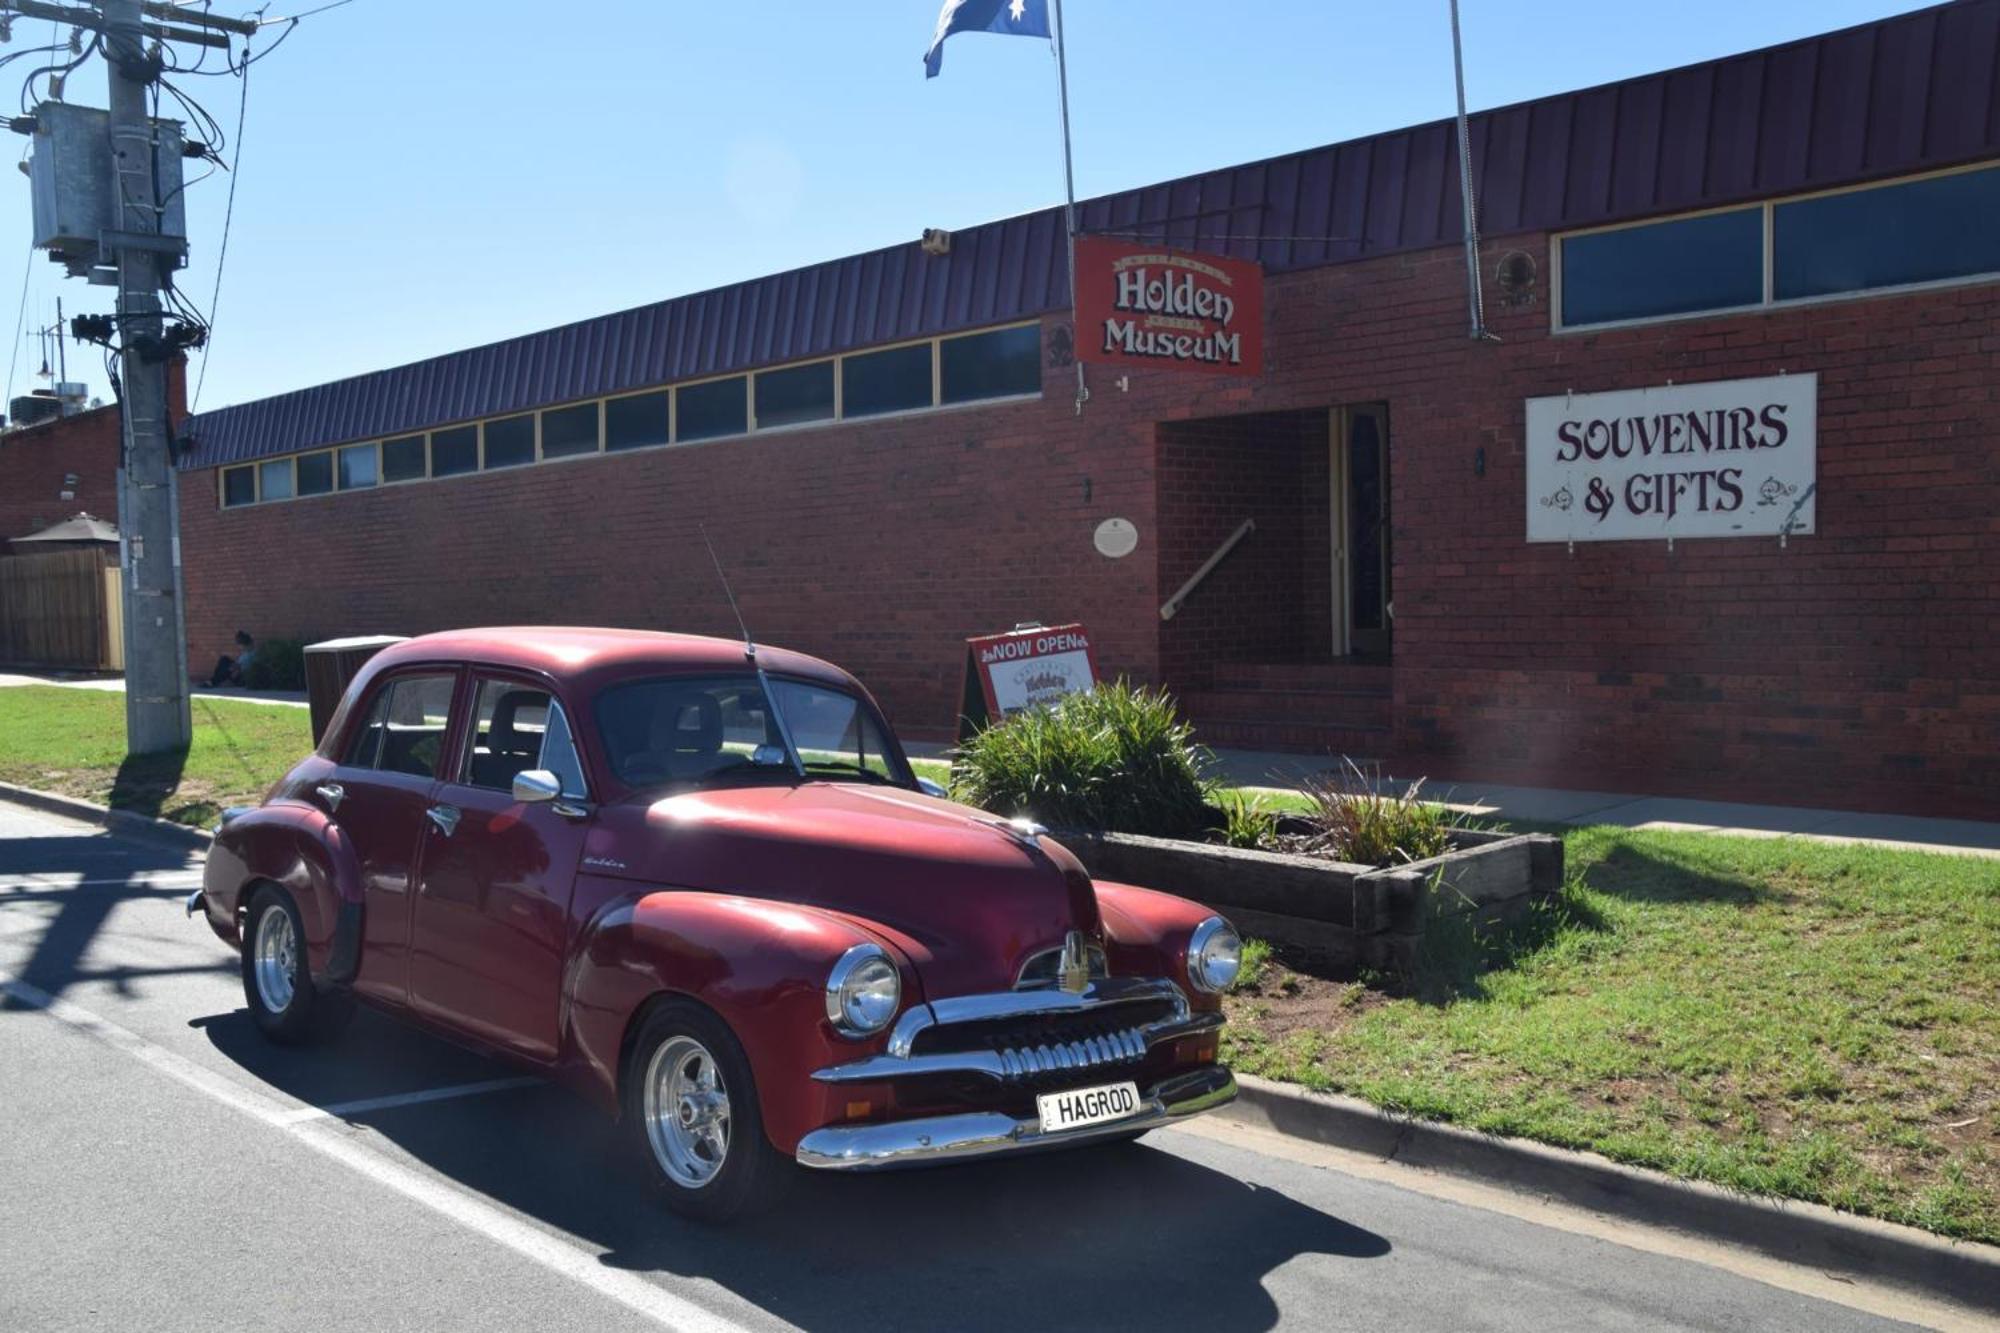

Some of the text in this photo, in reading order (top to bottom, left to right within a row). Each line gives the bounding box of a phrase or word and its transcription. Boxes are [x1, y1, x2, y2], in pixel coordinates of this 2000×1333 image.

[1117, 268, 1234, 325] Holden
[1557, 404, 1789, 462] SOUVENIRS
[1584, 468, 1744, 522] & GIFTS
[992, 634, 1077, 659] NOW OPEN
[1058, 1088, 1133, 1123] HAGROD
